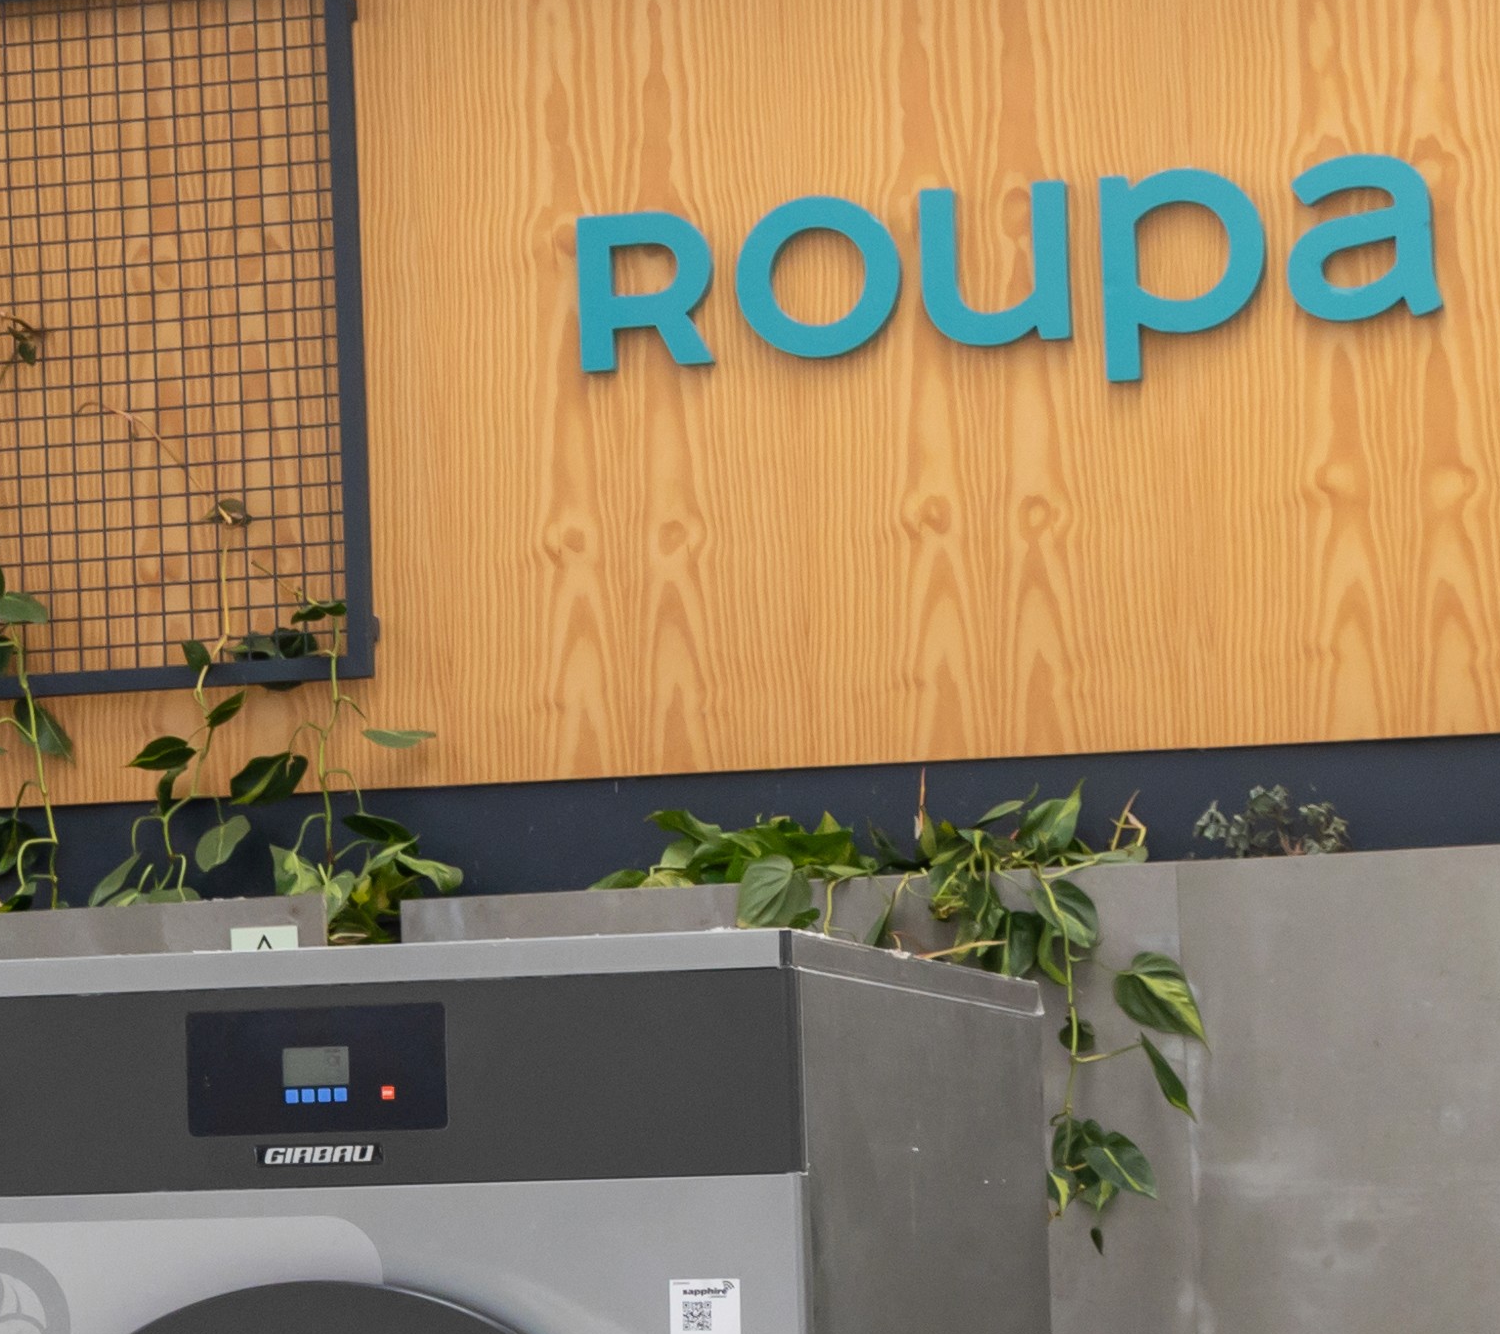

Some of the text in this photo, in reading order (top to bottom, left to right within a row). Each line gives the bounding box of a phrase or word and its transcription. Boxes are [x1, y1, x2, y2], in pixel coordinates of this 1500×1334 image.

[576, 153, 1443, 383] Roupa
[263, 1144, 375, 1165] GIRBAU
[682, 1287, 728, 1297] sapphire
